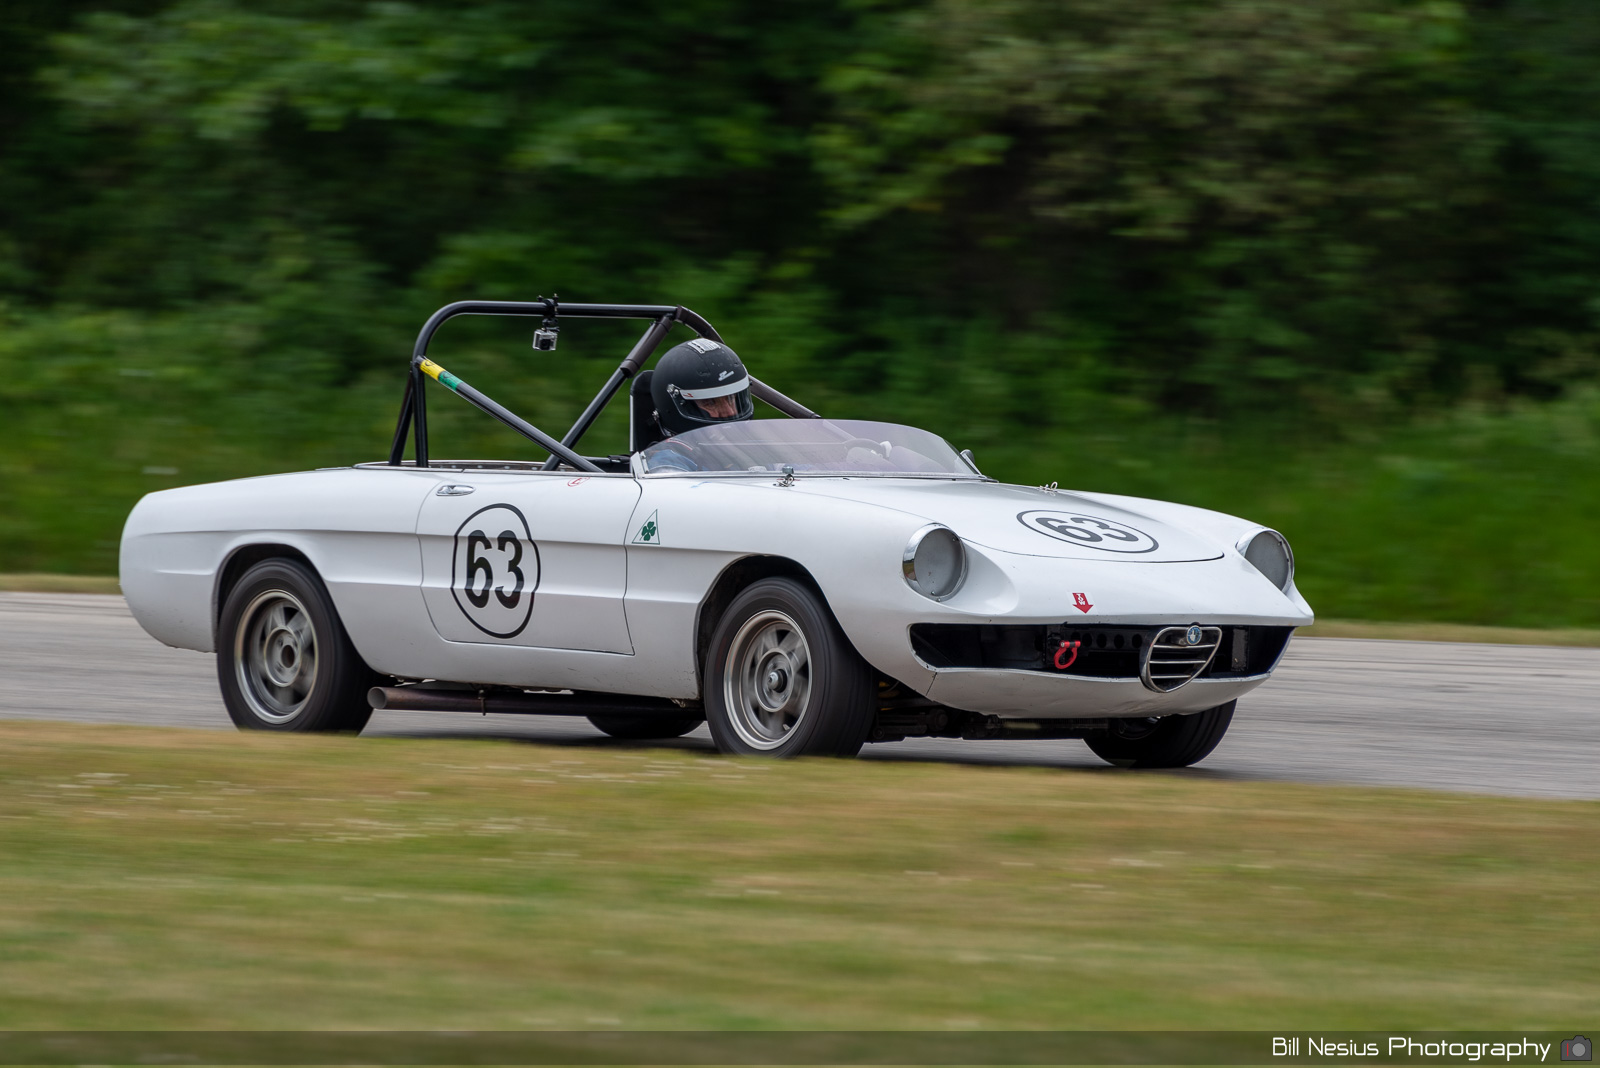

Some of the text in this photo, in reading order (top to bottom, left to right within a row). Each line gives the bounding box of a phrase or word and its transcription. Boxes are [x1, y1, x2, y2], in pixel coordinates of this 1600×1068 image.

[1035, 517, 1139, 542] 63
[464, 529, 525, 609] 63
[1075, 593, 1087, 606] TOW
